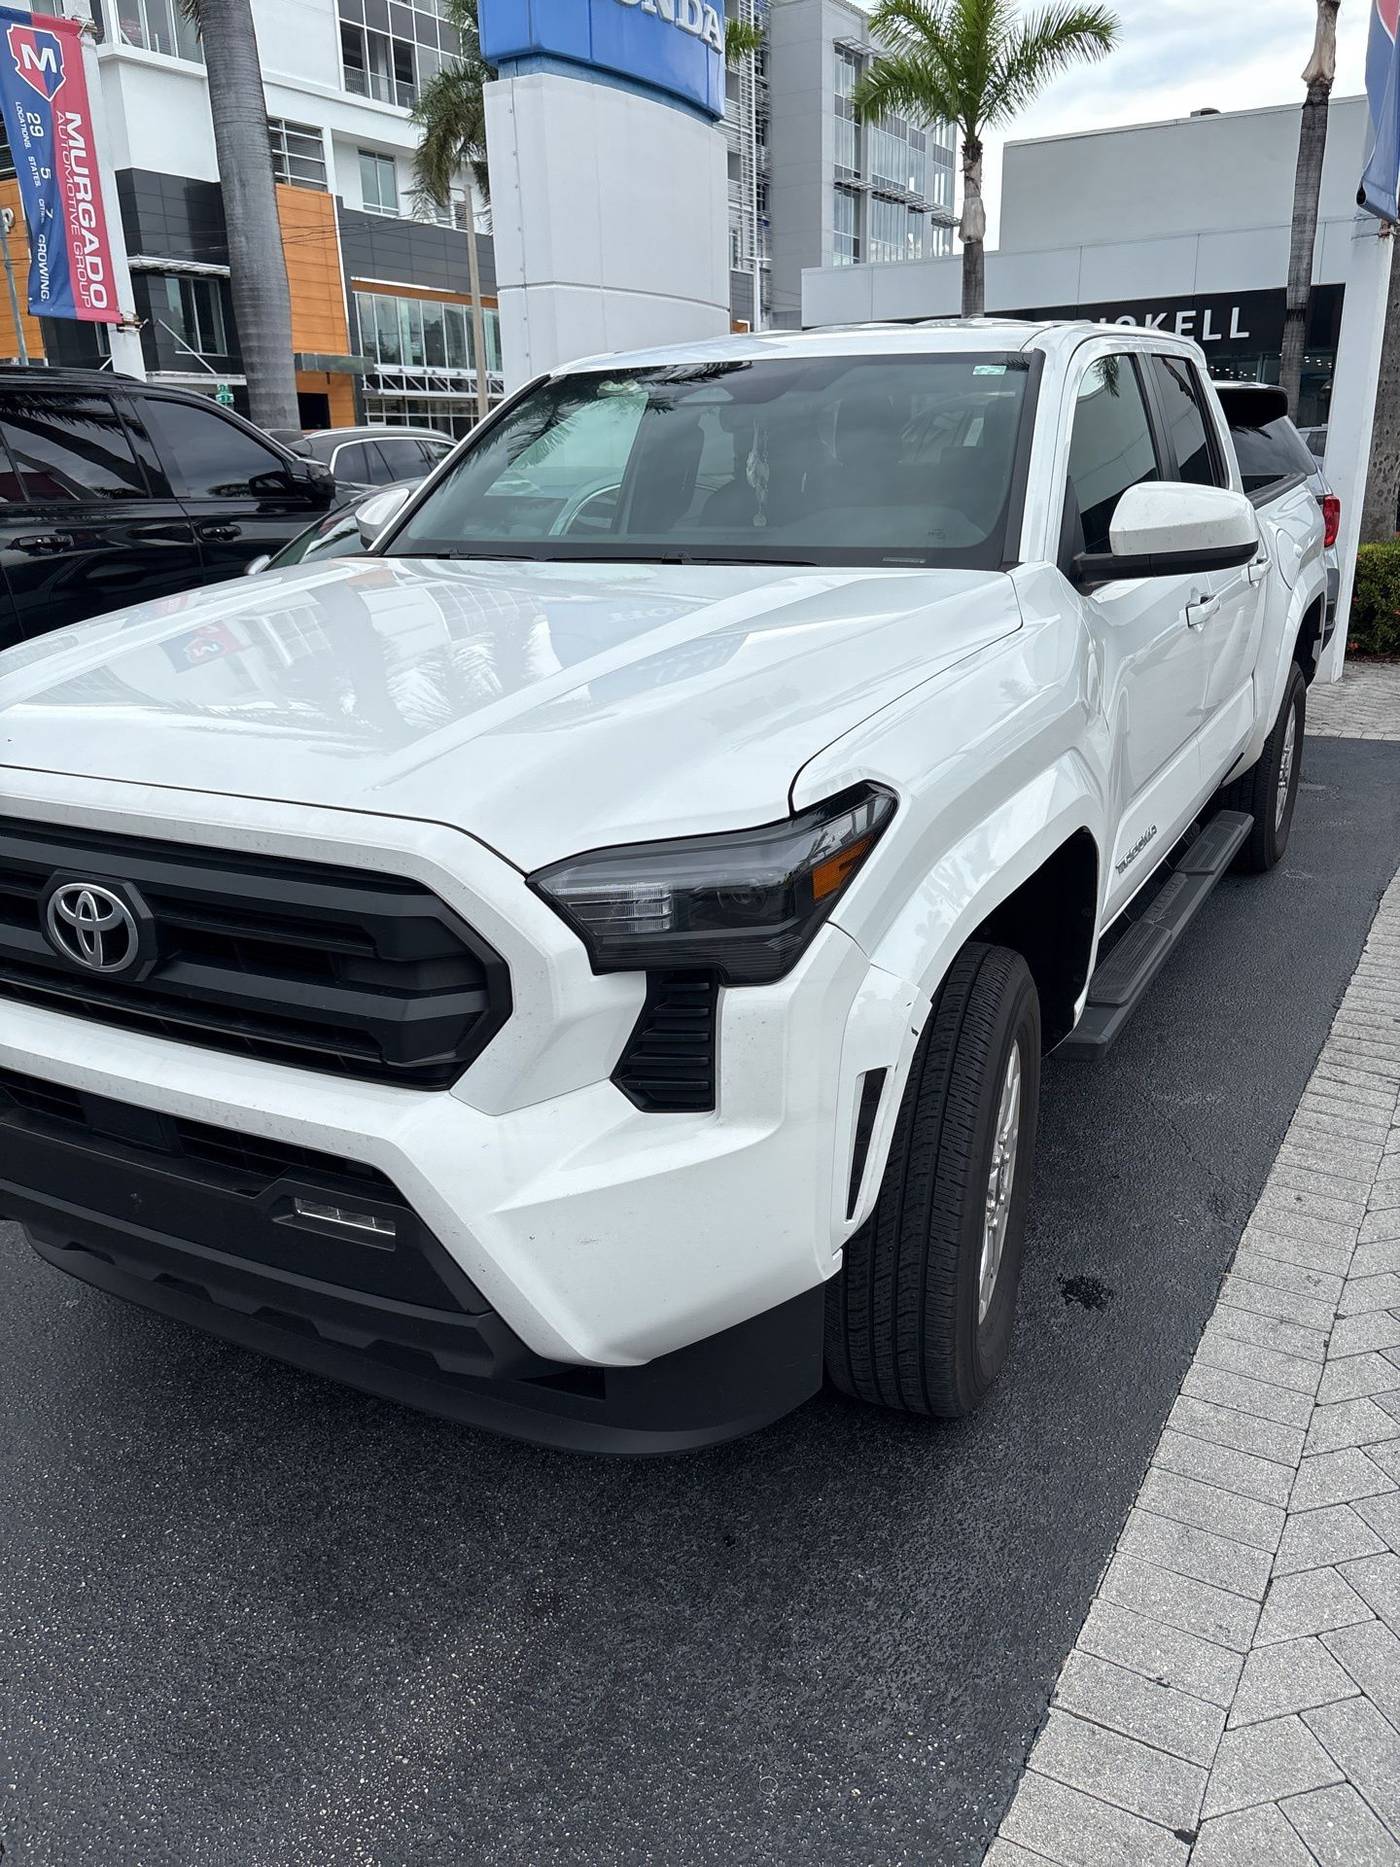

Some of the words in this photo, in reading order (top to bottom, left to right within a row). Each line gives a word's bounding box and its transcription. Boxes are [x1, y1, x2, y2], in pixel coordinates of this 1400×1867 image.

[21, 43, 57, 73] M
[26, 112, 44, 137] 29
[40, 167, 52, 179] 5
[56, 111, 81, 235] AUTOMOTIVE
[73, 241, 91, 308] GROUP
[65, 111, 107, 309] MURGADO
[37, 234, 50, 302] GROWING.
